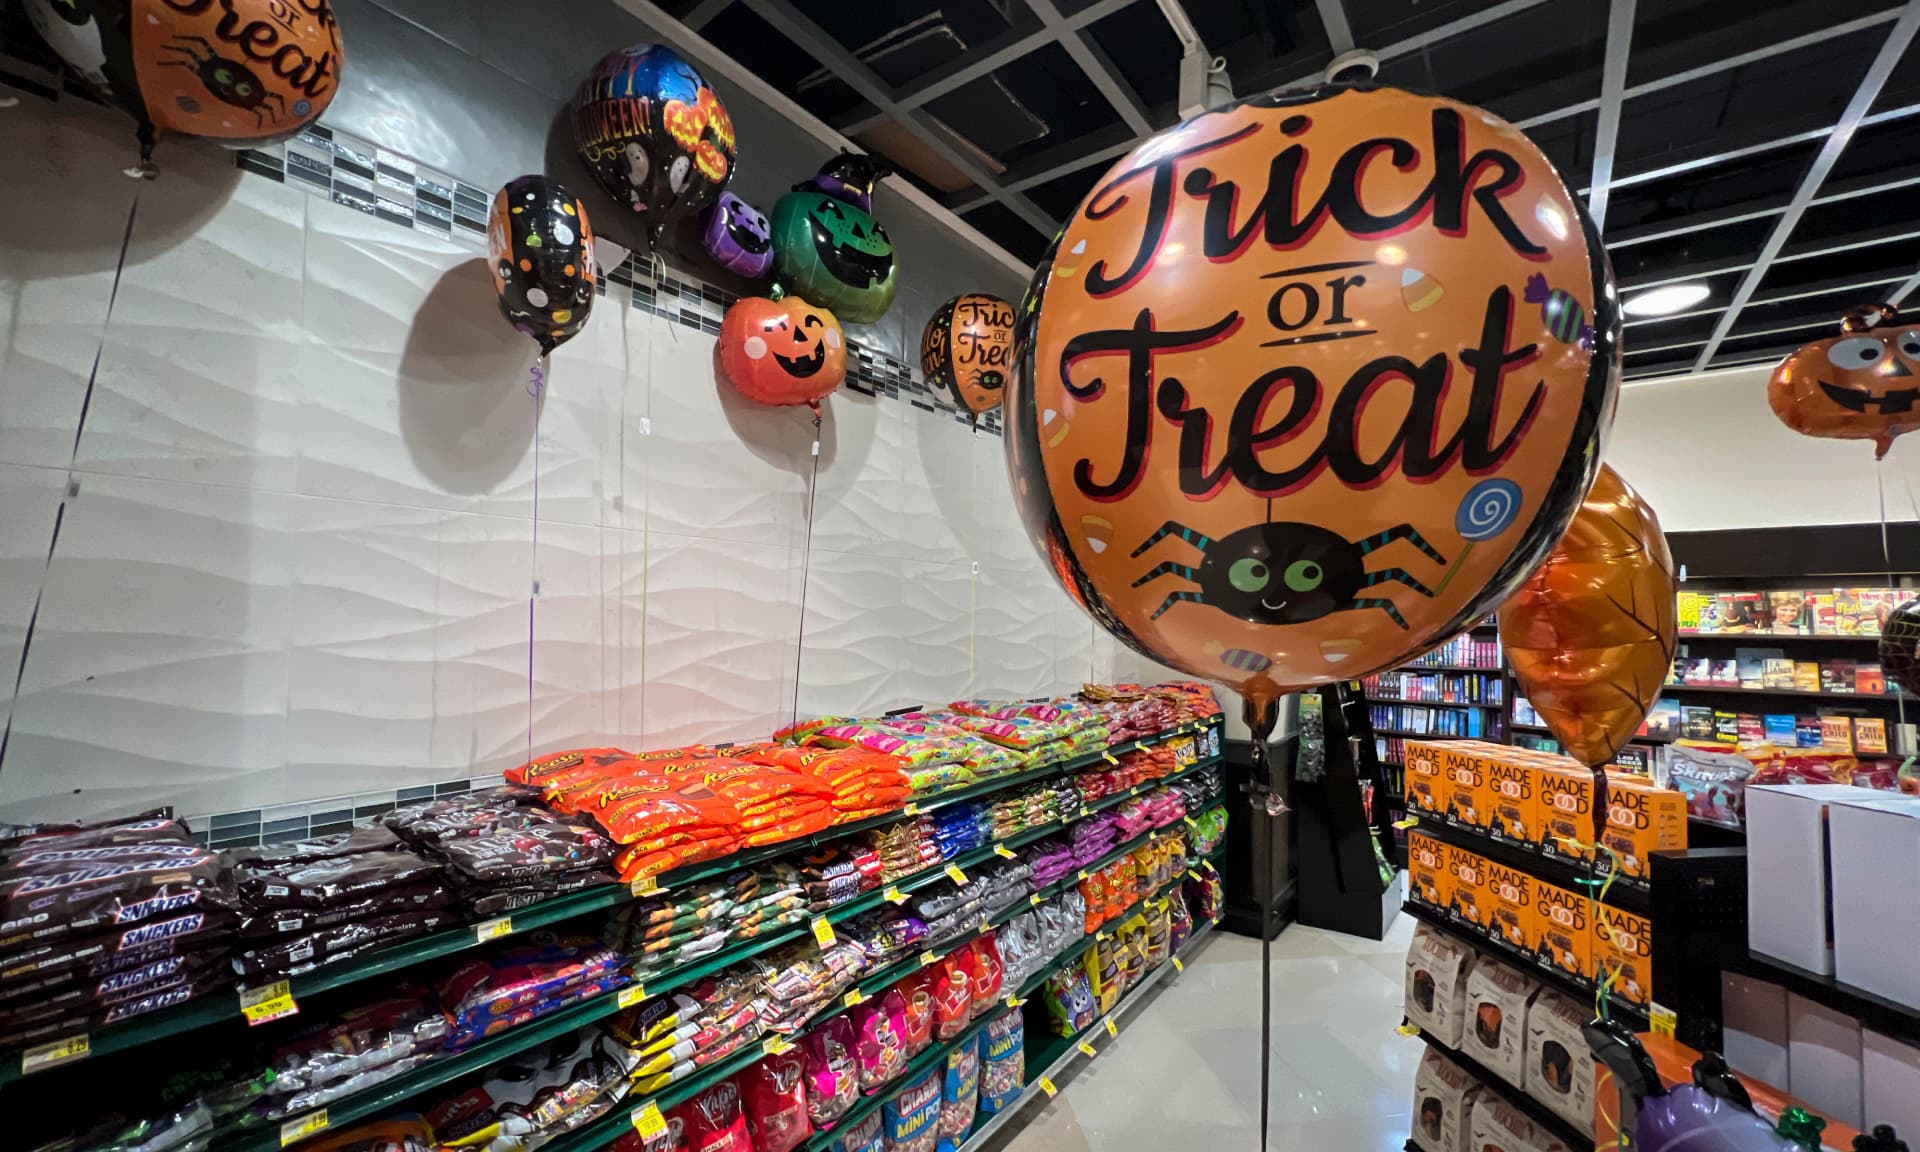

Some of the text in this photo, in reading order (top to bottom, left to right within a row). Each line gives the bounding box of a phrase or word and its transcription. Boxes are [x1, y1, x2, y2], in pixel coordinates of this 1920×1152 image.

[1085, 108, 1552, 298] Trick
[1266, 272, 1366, 331] or
[958, 301, 1016, 329] Tric
[1060, 285, 1546, 501] Treat
[1407, 746, 1440, 763] MADE
[1446, 754, 1482, 774] MADE
[1407, 758, 1440, 776] GOOD
[1446, 767, 1483, 787] GOOD
[1489, 763, 1531, 785] MADE
[1489, 777, 1531, 799] GOOD
[1541, 774, 1589, 798] MADE
[1541, 790, 1589, 814] GOOD
[1609, 806, 1650, 830] OOD
[1411, 835, 1444, 857] MADE
[1411, 847, 1443, 869] GOOD
[1450, 848, 1485, 873] MADE
[1450, 862, 1485, 886] GOOD
[1489, 865, 1528, 892] MADE
[1489, 879, 1529, 906] GOOD
[1537, 885, 1585, 915] MADE
[1537, 900, 1585, 930] GOOD
[123, 914, 201, 946] SNICKERS
[925, 1097, 941, 1121] PO
